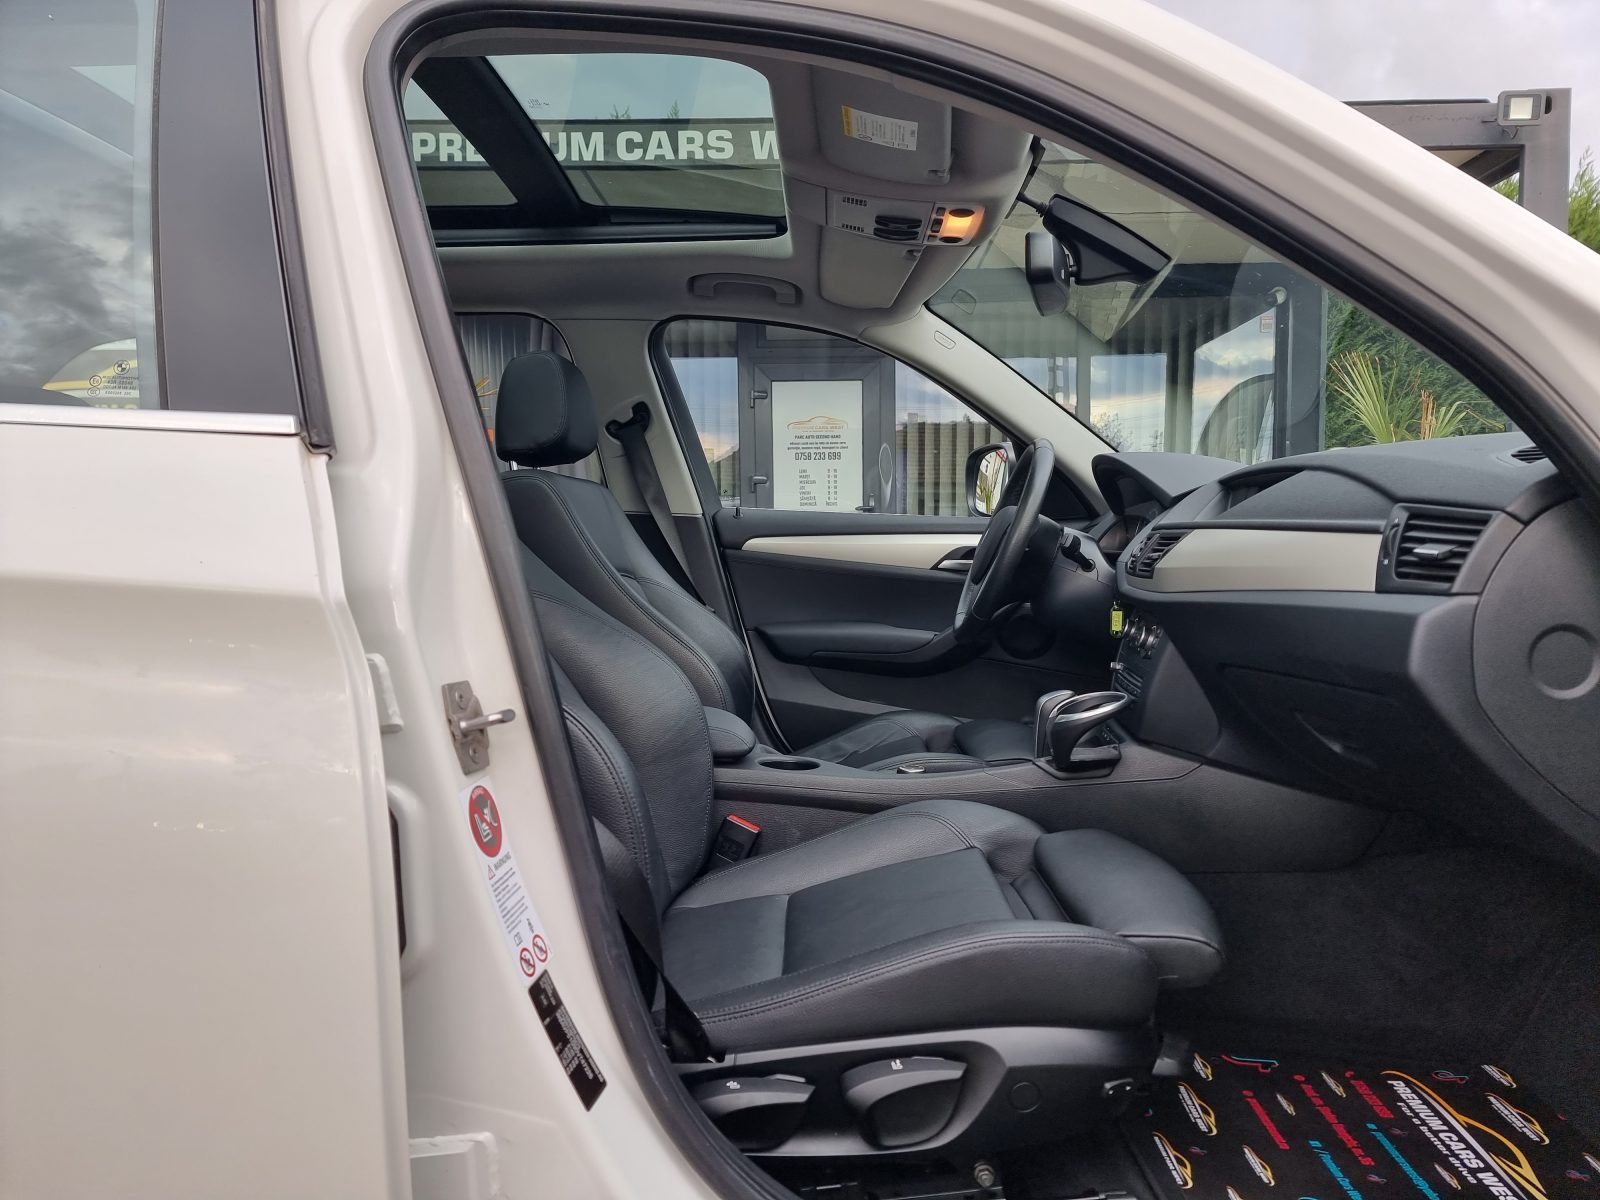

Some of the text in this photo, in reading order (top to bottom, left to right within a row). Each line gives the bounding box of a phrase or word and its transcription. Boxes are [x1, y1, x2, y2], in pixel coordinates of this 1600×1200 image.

[616, 129, 734, 161] CARS
[795, 451, 842, 461] 0758 233 699
[1386, 1080, 1449, 1131] PREMIUM
[1438, 1132, 1485, 1169] CARS
[1411, 1118, 1422, 1126] a
[1419, 1125, 1451, 1156] better
[1448, 1156, 1478, 1184] drive
